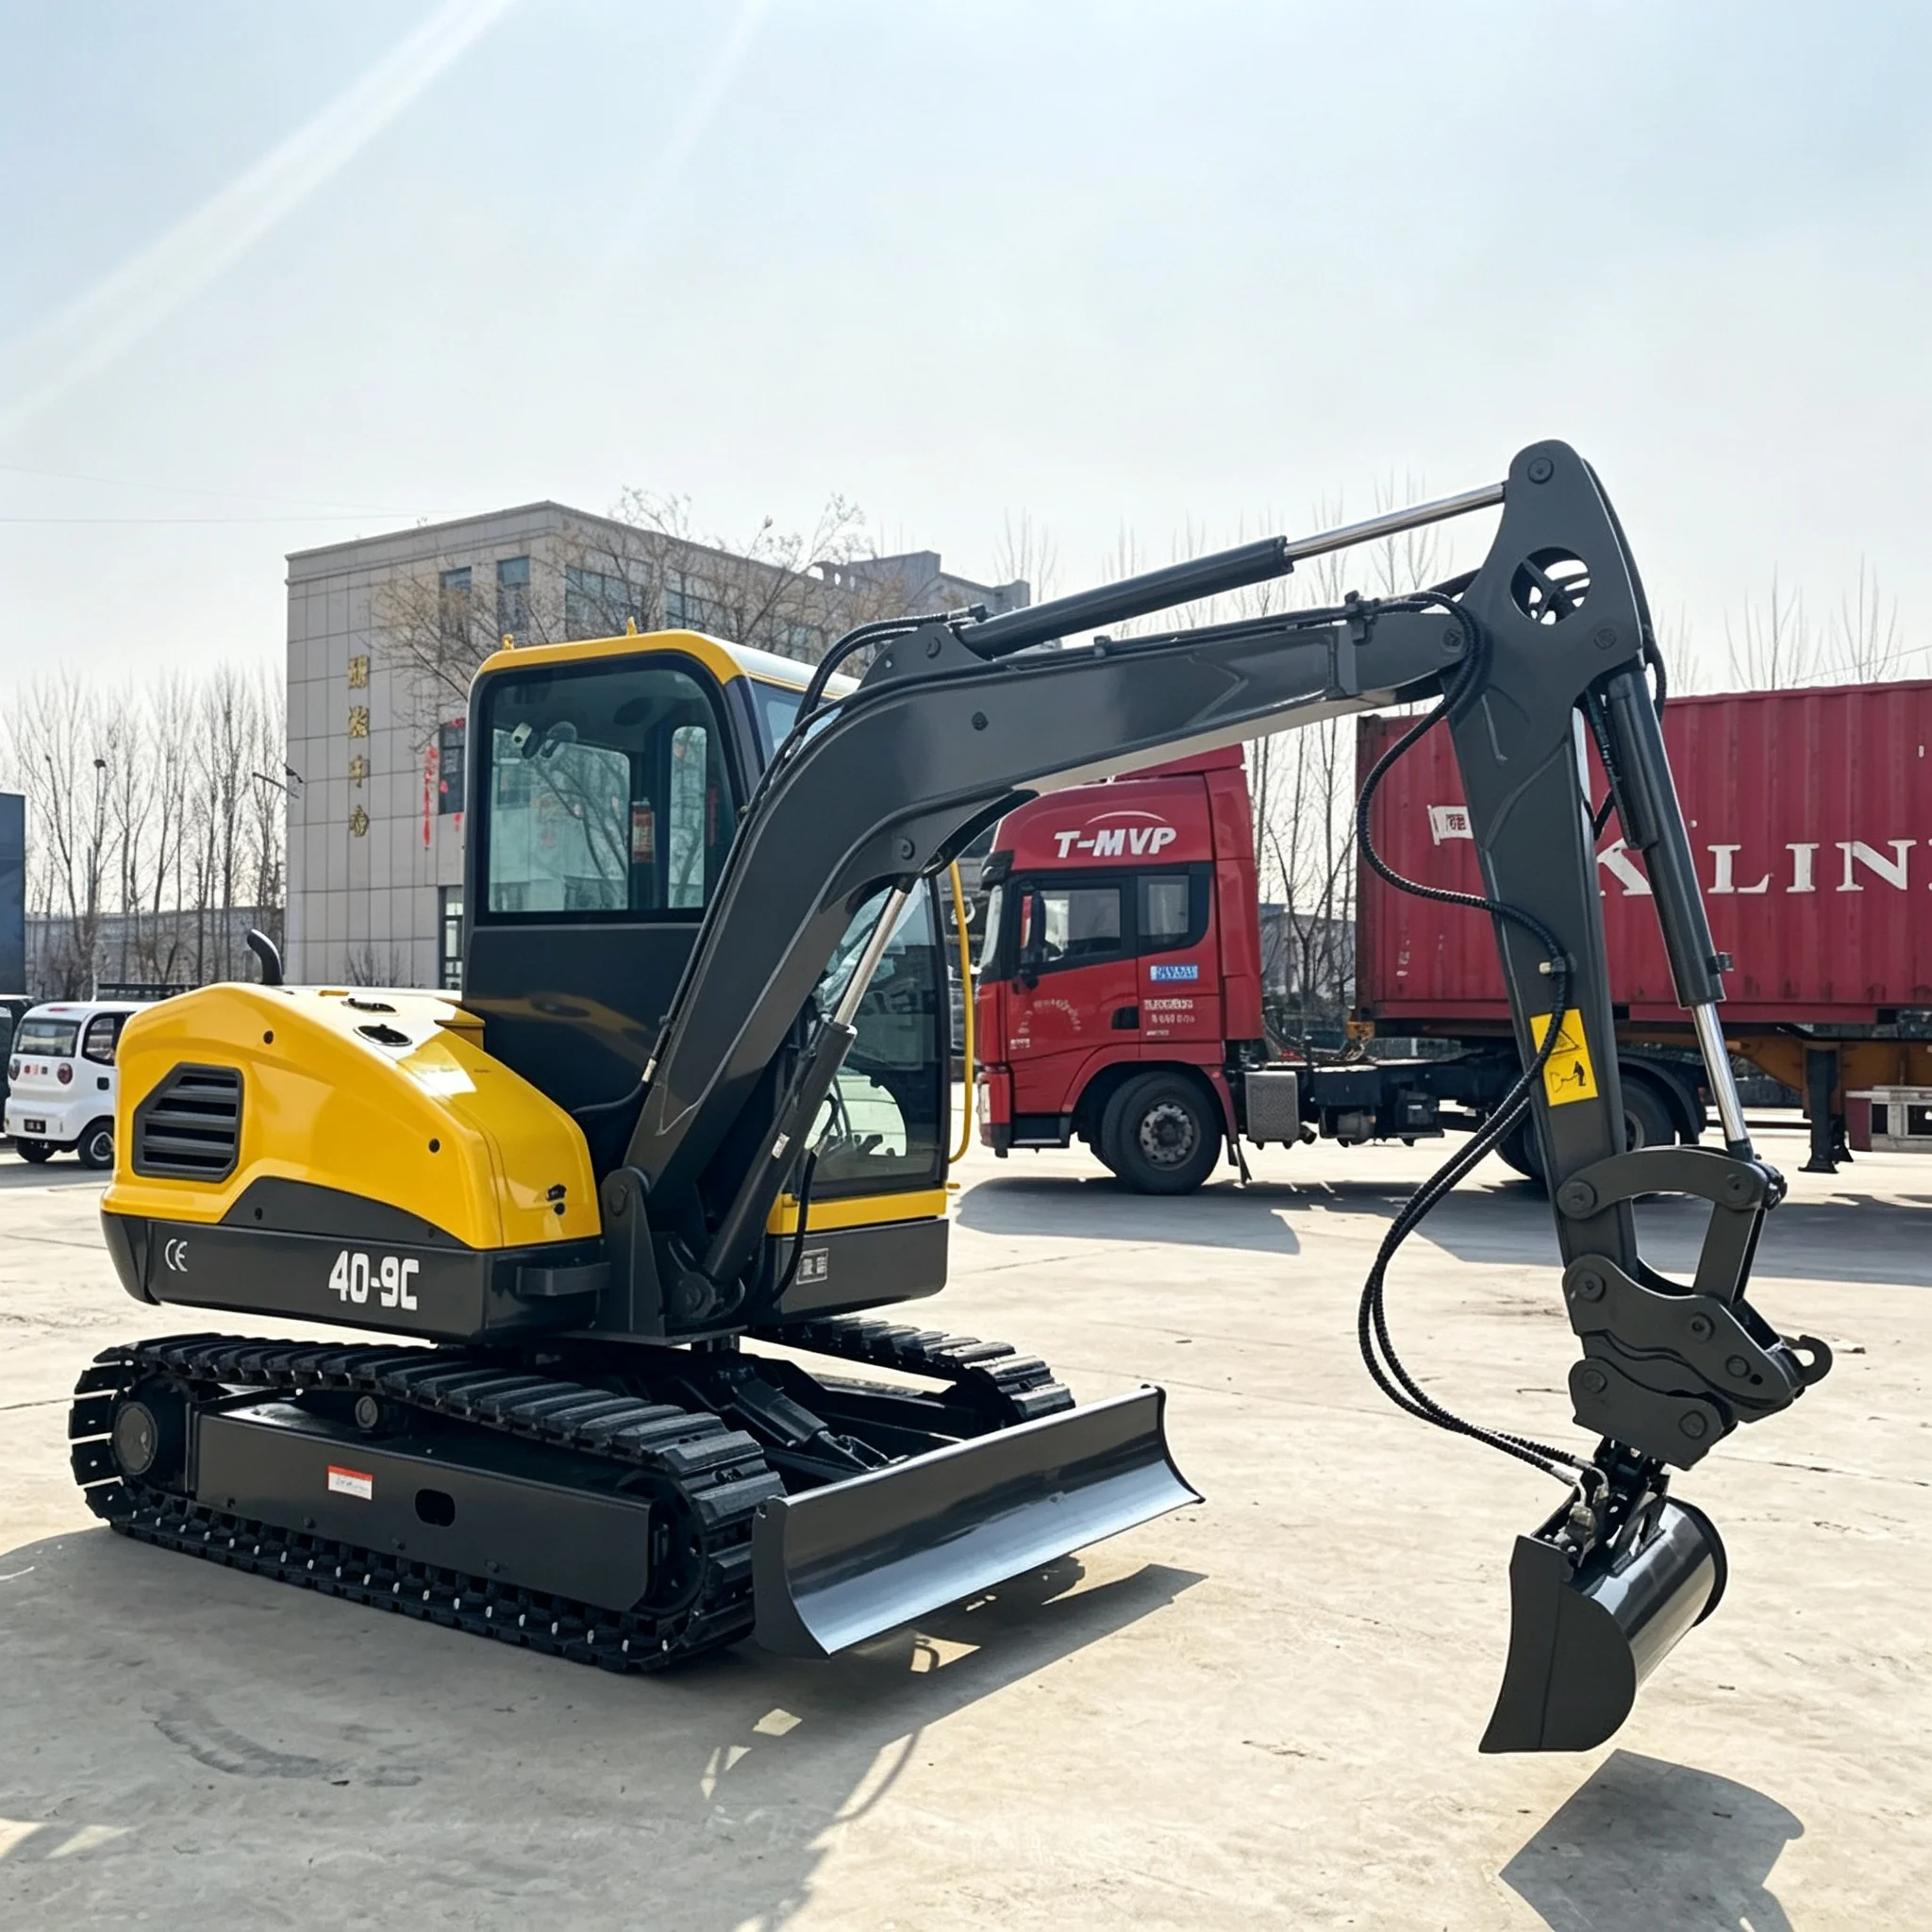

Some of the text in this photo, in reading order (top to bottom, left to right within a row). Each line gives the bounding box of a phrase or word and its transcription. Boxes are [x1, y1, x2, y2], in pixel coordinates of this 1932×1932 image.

[1054, 827, 1176, 858] T-MVP
[1707, 839, 1932, 894] LIN
[328, 1250, 420, 1311] 40-9C
